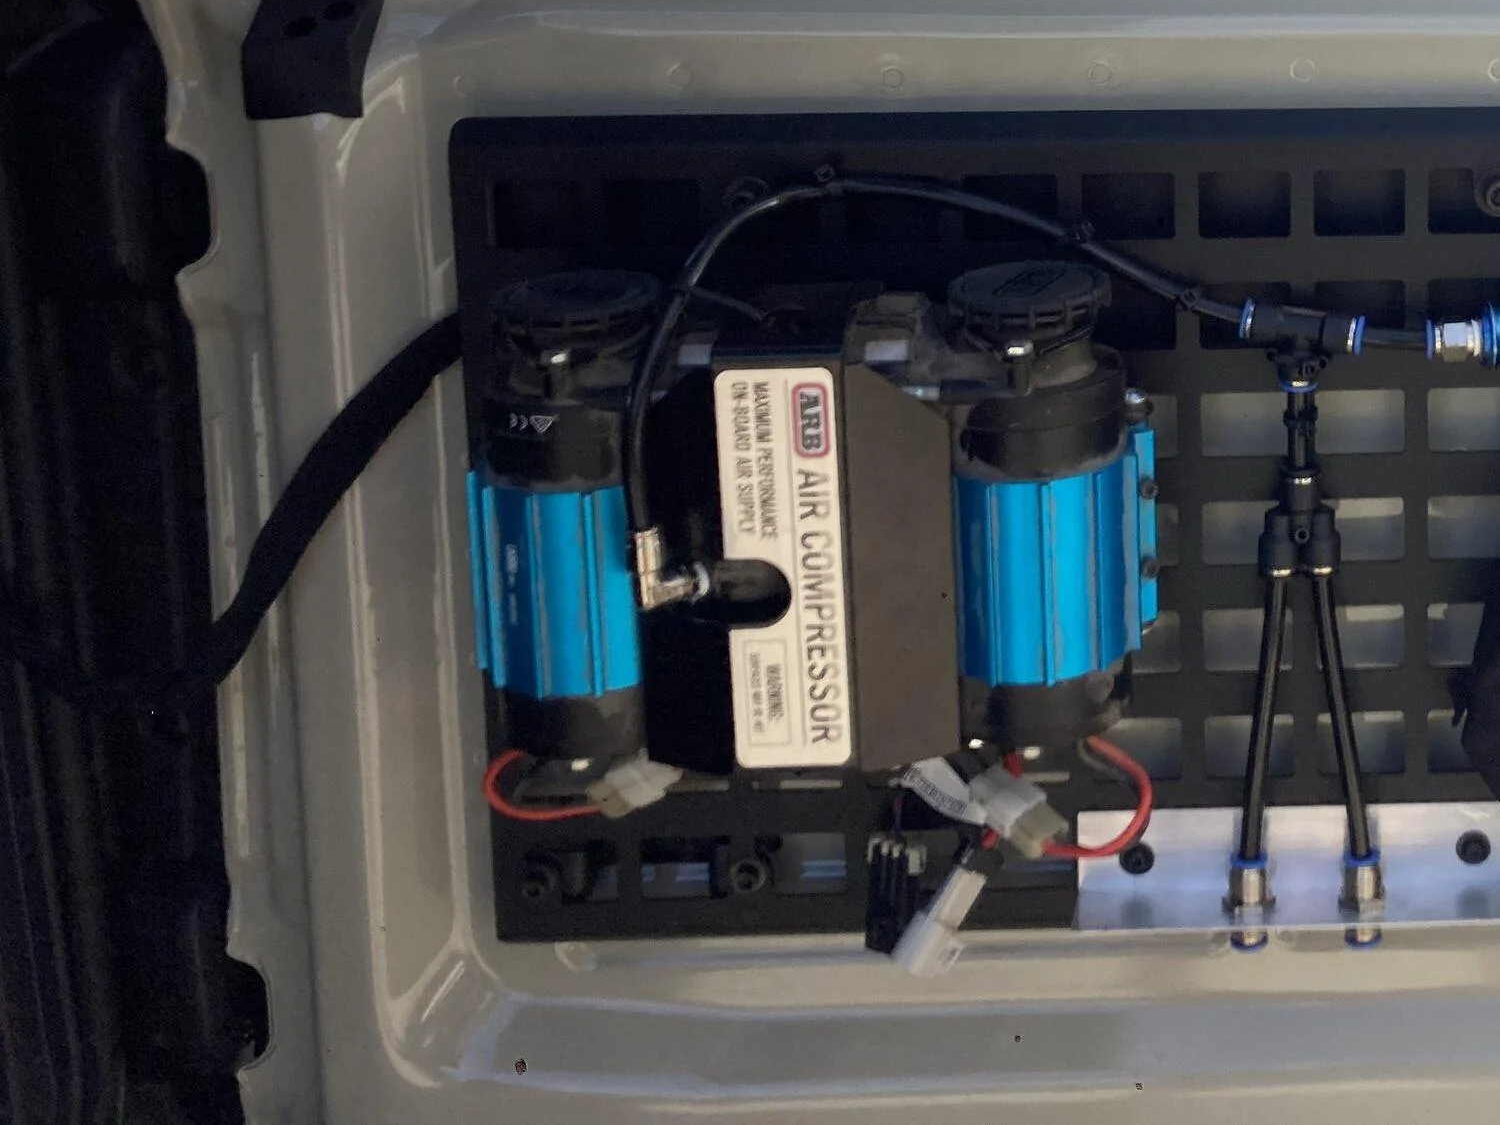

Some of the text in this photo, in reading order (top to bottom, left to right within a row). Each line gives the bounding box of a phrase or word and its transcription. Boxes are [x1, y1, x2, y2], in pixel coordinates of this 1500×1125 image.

[732, 381, 757, 535] ON-BOARD AIR SUPPLY
[754, 381, 779, 542] MAXIMUM PERFORMANCE
[798, 389, 825, 452] ARB
[797, 469, 843, 744] AIR COMPRESSOR
